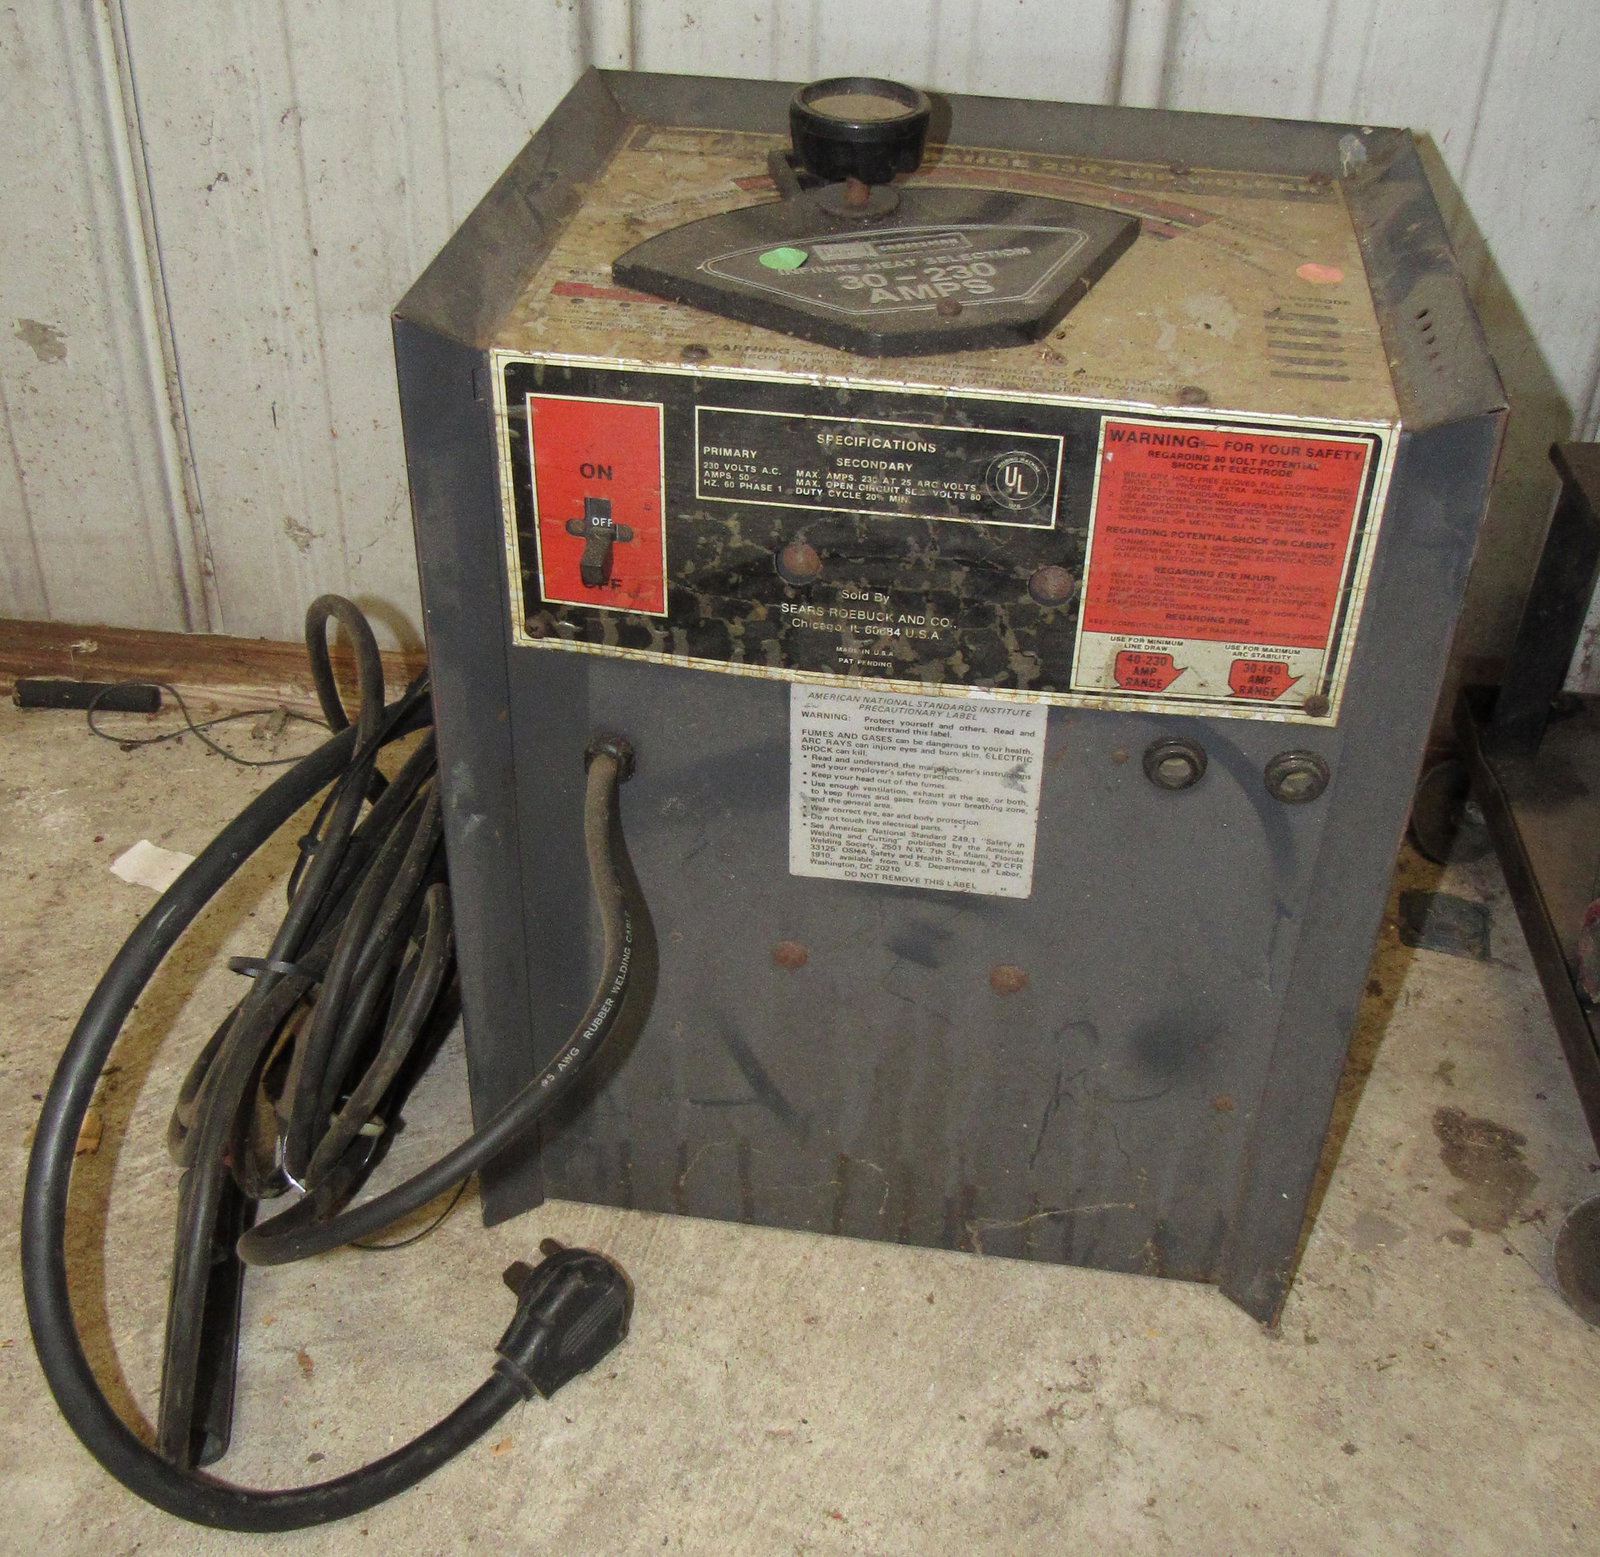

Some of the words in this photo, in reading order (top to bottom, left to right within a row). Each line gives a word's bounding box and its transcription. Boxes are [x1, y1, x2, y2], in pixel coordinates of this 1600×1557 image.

[866, 257, 917, 270] HEAT
[922, 246, 1033, 265] SELECTION
[837, 272, 889, 291] 30
[922, 261, 997, 282] 230
[868, 278, 997, 304] AMPS
[816, 433, 936, 453] SPECIFICATIONS
[1223, 440, 1253, 452] FOR
[1259, 443, 1300, 456] YOUR
[1305, 447, 1361, 461] SAFETY
[703, 446, 757, 459] PRIMARY
[1147, 450, 1210, 462] REGARDING
[1229, 456, 1256, 465] VOLT
[1260, 459, 1319, 470] POTENTIAL
[580, 463, 613, 480] ON
[724, 463, 756, 472] VOLTS
[762, 467, 781, 475] A.C.
[836, 457, 912, 472] SECONDARY
[1170, 461, 1208, 470] SHOCK
[1212, 464, 1225, 472] AT
[1228, 465, 1292, 477] ELECTRODE
[704, 470, 733, 479] AMPS.
[739, 473, 749, 481] 50
[796, 469, 820, 478] MAX.
[826, 472, 856, 481] AMPS.
[882, 477, 895, 485] AT
[901, 478, 911, 486] 25
[917, 480, 938, 488] ARC
[943, 482, 976, 491] VOLTS
[1004, 466, 1029, 496] UL
[703, 479, 719, 487] HZ.
[724, 480, 734, 488] 60
[739, 482, 772, 491] PHASE
[795, 478, 820, 487] MAX.
[825, 481, 853, 490] OPEN
[858, 483, 899, 494] CIRCUIT
[932, 490, 965, 499] VOLTS
[795, 487, 822, 496] DUTY
[828, 489, 861, 499] CYCLE
[592, 517, 613, 527] OFF
[1106, 526, 1167, 536] REGARDING
[1170, 531, 1228, 541] POTENTIAL
[1231, 535, 1267, 544] SHOCK
[1290, 540, 1335, 549] CABINET
[1154, 566, 1214, 577] REGARDING
[1217, 571, 1237, 579] EYE
[1240, 573, 1275, 582] INJURY
[841, 589, 868, 601] Sold
[874, 592, 889, 604] By
[781, 602, 824, 616] SEARS
[829, 606, 894, 623] ROEBUCK
[898, 613, 925, 626] AND
[1165, 613, 1225, 623] REGARDING
[905, 628, 942, 641] U.S.A.
[1251, 652, 1290, 660] STABILITY
[1261, 647, 1300, 655] MAXIMUM
[1132, 666, 1156, 676] AMP
[1124, 677, 1162, 688] RANGE
[1246, 675, 1272, 685] AMP
[1238, 685, 1277, 696] RANGE
[808, 691, 858, 702] AMERICAN
[862, 696, 913, 706] NATIONAL
[916, 700, 976, 712] STANDARDS
[979, 706, 1031, 717] INSTITUTE
[858, 703, 943, 717] PRECAUTIONARY
[946, 711, 977, 720] LABEL
[864, 716, 894, 724] Protect
[900, 719, 933, 729] yourself
[938, 722, 953, 730] and
[993, 727, 1014, 735] Read
[864, 724, 909, 734] understand
[801, 728, 833, 737] FUMES
[861, 734, 892, 742] GASES
[926, 739, 967, 750] dangerous
[801, 744, 832, 753] SHOCK
[801, 736, 820, 744] ARC
[825, 738, 851, 746] RAYS
[873, 743, 895, 751] injure
[985, 752, 1032, 763] ELECTRIC
[853, 757, 898, 767] understand
[811, 771, 831, 779] Keep
[849, 765, 894, 775] employer's
[896, 770, 920, 778] safety
[875, 864, 900, 872] 20210
[882, 874, 920, 883] REMOVE
[947, 880, 976, 888] LABEL
[557, 1047, 580, 1072] AWG
[583, 997, 614, 1040] RUBBER
[610, 947, 632, 994] WELDING
